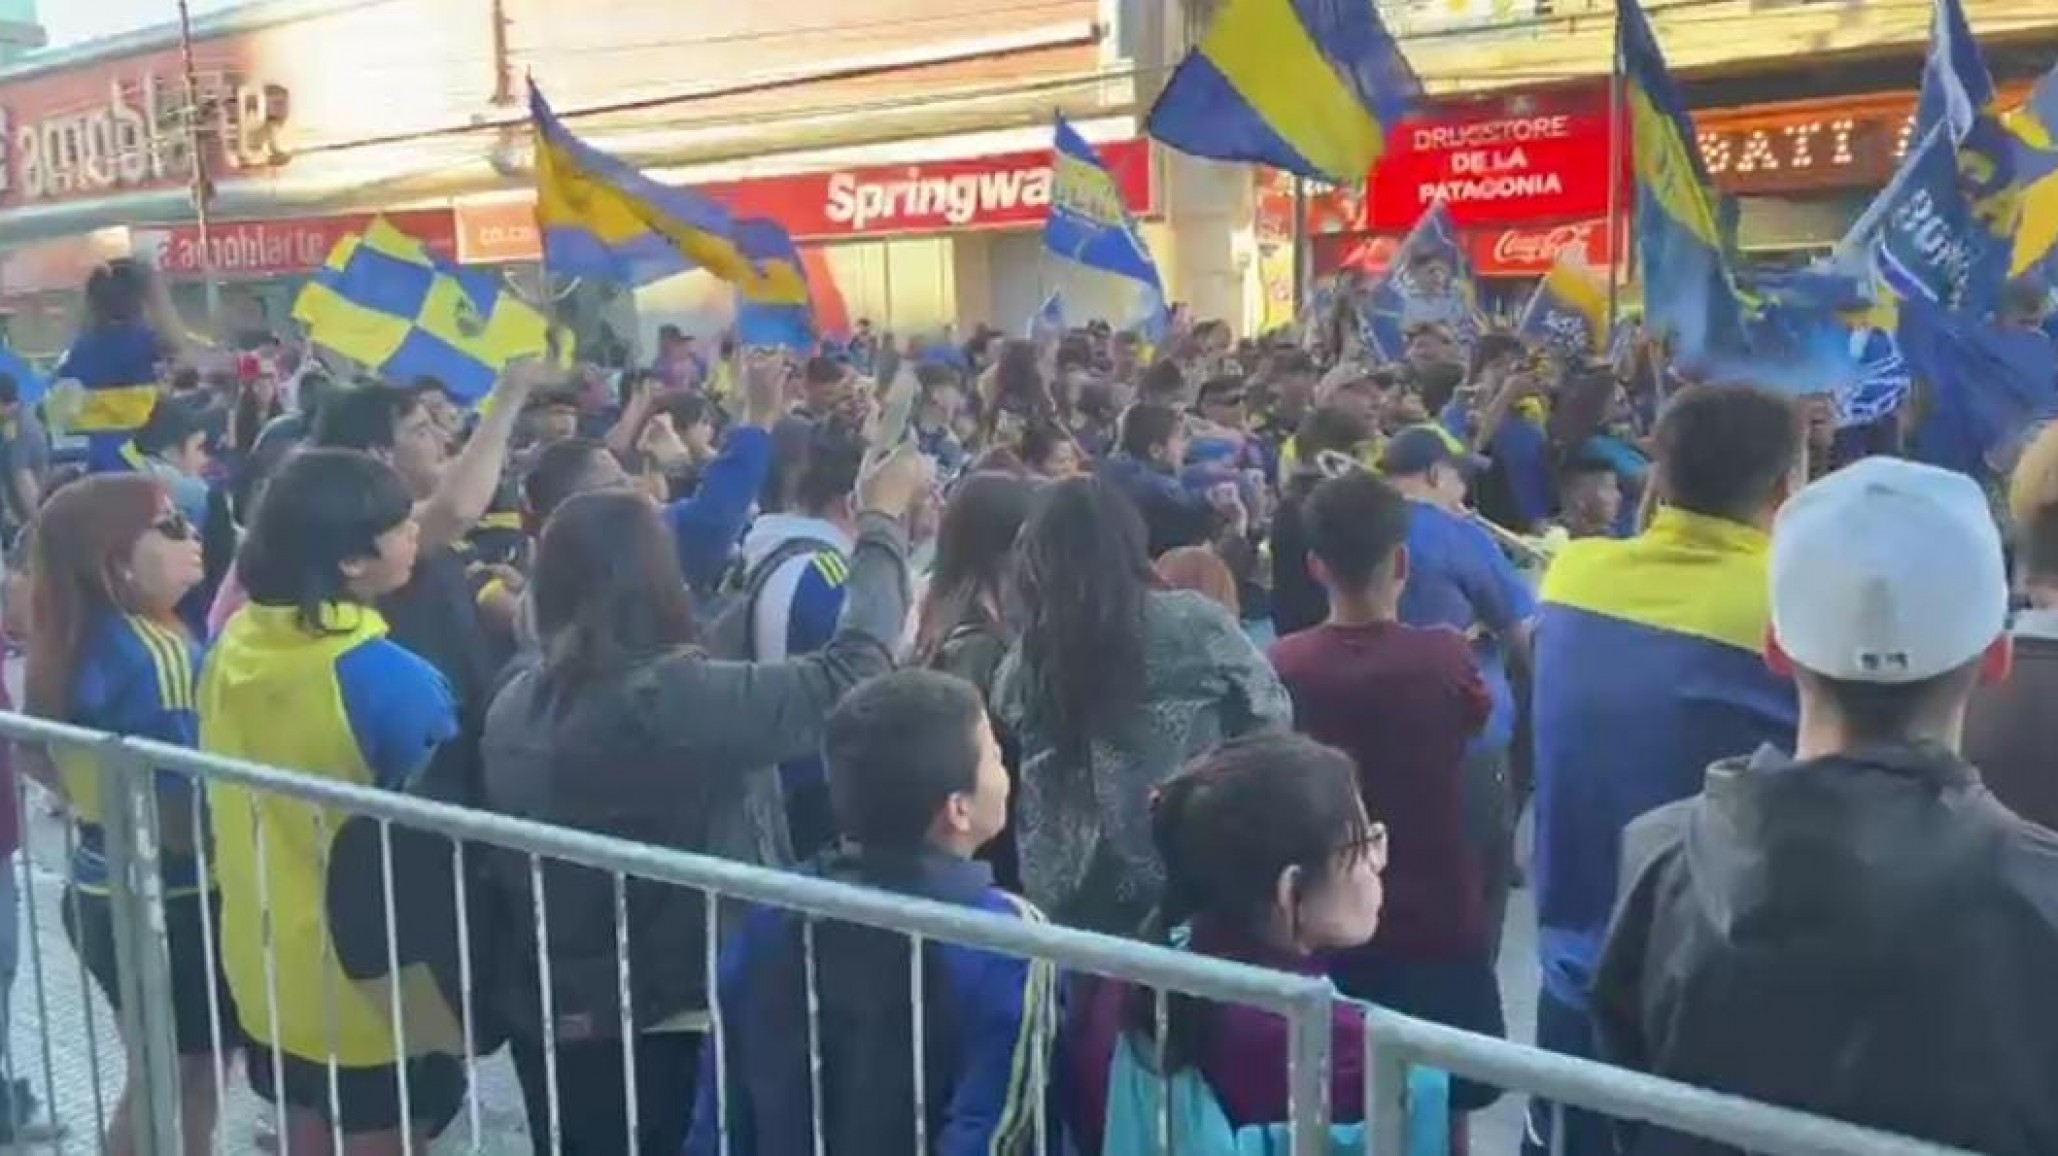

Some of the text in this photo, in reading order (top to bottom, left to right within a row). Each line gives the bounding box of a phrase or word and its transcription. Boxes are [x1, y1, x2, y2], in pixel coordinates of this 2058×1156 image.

[1451, 146, 1530, 175] DE LA
[1418, 172, 1564, 204] PATAGONIA
